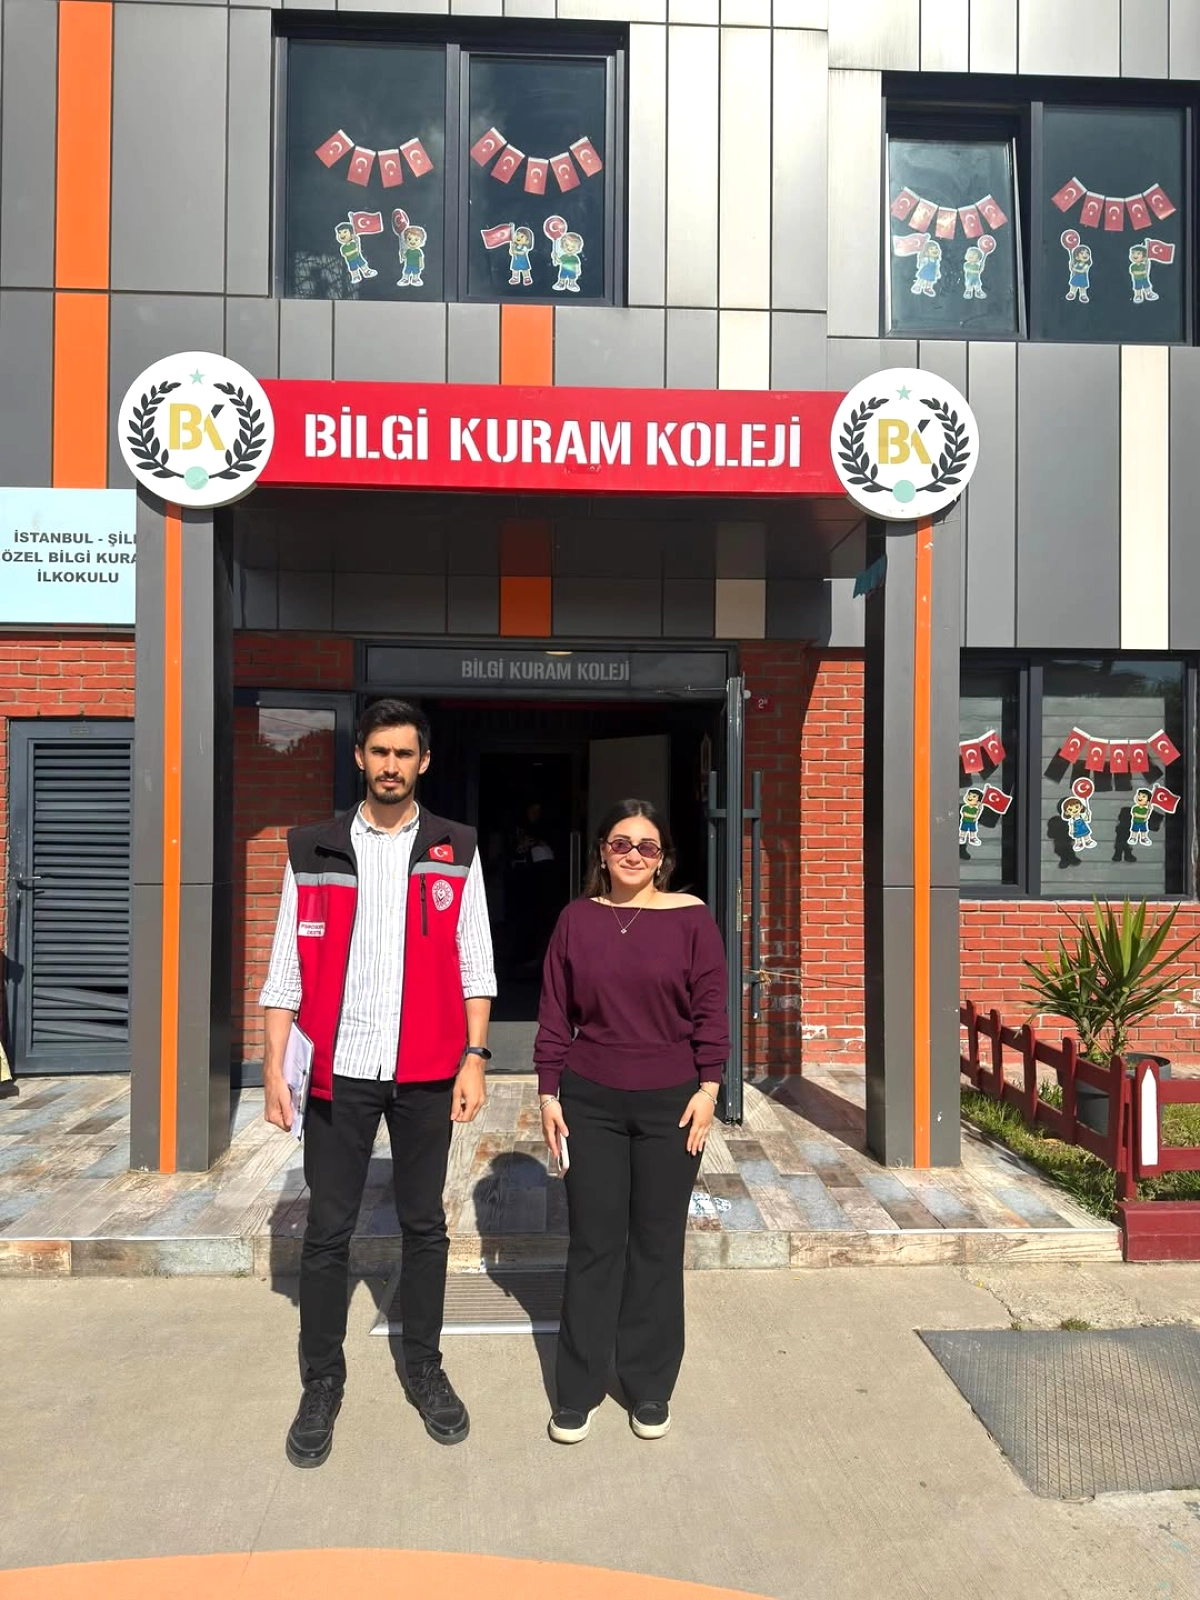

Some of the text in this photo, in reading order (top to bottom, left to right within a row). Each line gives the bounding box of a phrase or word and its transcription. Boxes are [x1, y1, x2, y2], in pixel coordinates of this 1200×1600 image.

[168, 403, 226, 450] BK
[305, 405, 801, 468] BİLGİ KURAM KOLEJİ
[878, 418, 932, 465] BK
[13, 529, 94, 544] İSTANBUL
[1, 549, 44, 563] ÖZEL
[48, 549, 91, 564] BİLGİ
[37, 568, 119, 583] İLKOKULU
[461, 658, 630, 681] BİLGİ KURAM KOLEJİ
